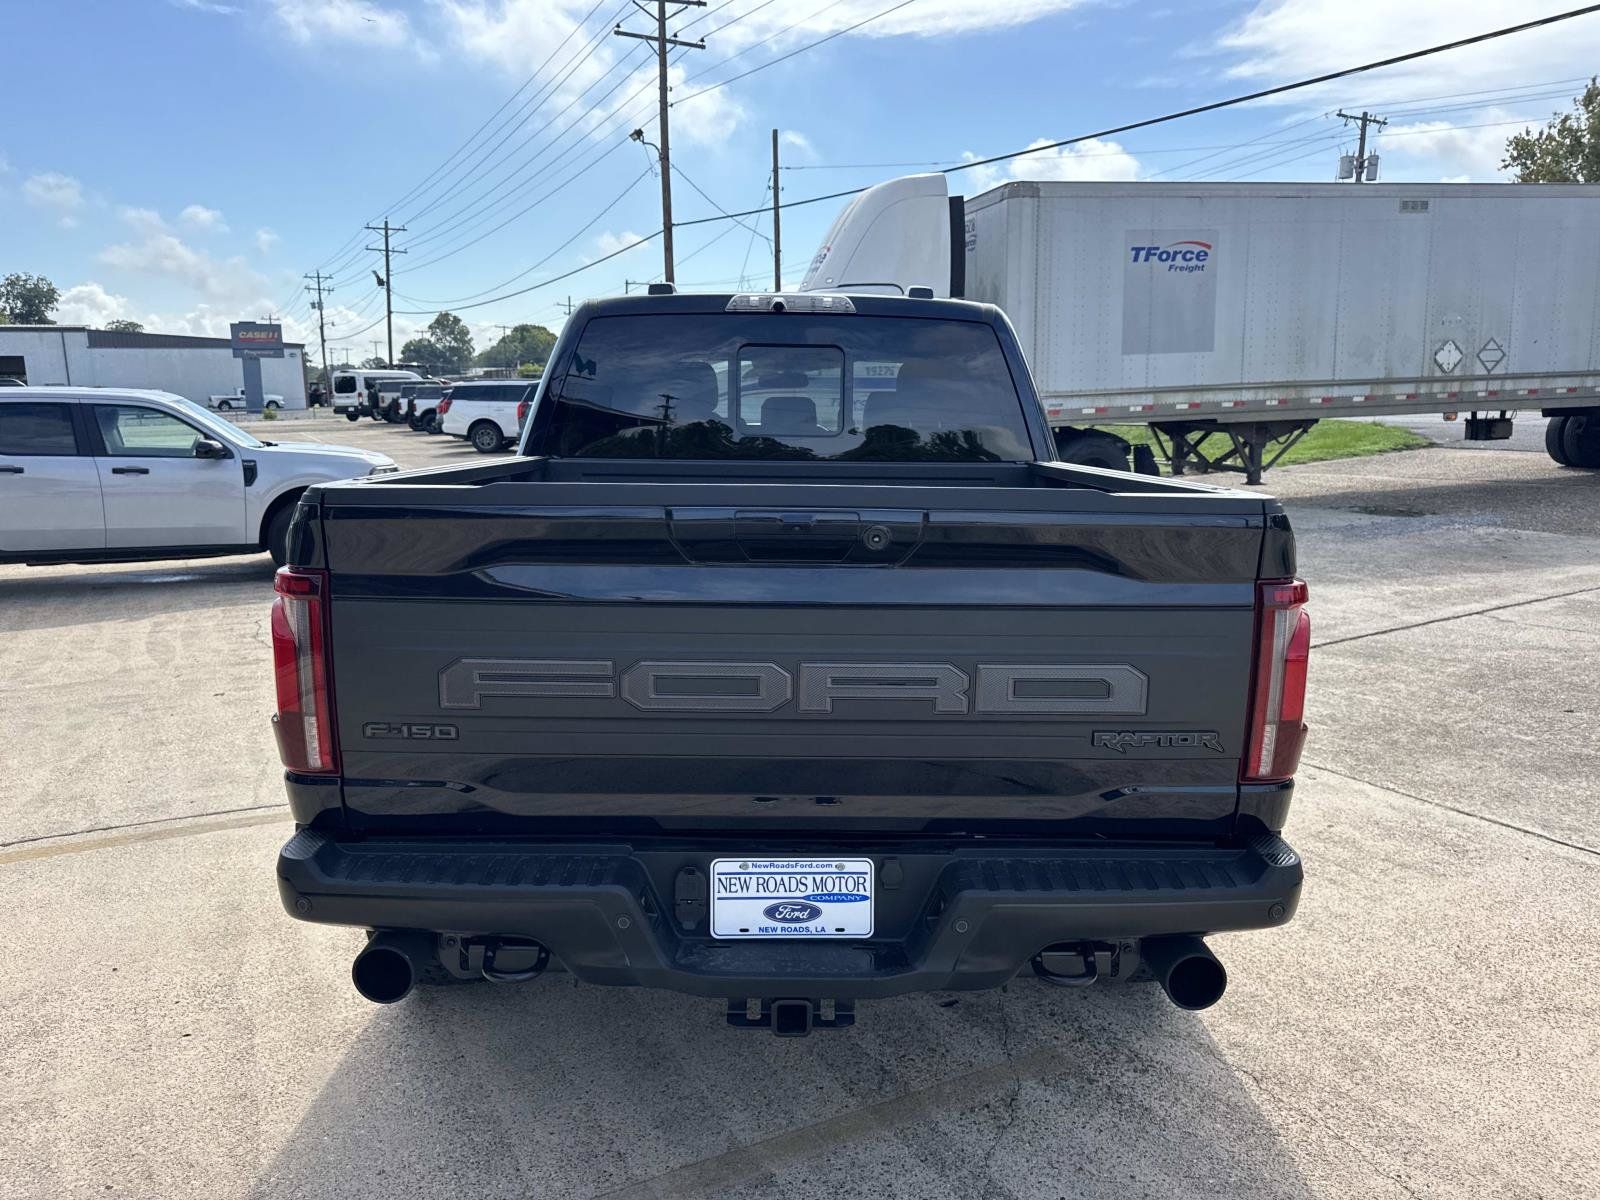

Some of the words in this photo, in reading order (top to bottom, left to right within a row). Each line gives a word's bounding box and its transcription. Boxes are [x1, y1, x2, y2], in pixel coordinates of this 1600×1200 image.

[1131, 246, 1208, 262] TForce
[1168, 264, 1205, 273] Freight
[439, 658, 1149, 716] FORD
[363, 722, 459, 740] F-150
[1092, 730, 1224, 753] RAPTOR
[717, 877, 752, 893] NEW
[756, 876, 808, 893] ROADS
[812, 876, 867, 893] MOTOR
[775, 904, 811, 919] Ford
[780, 926, 813, 934] ROADS,
